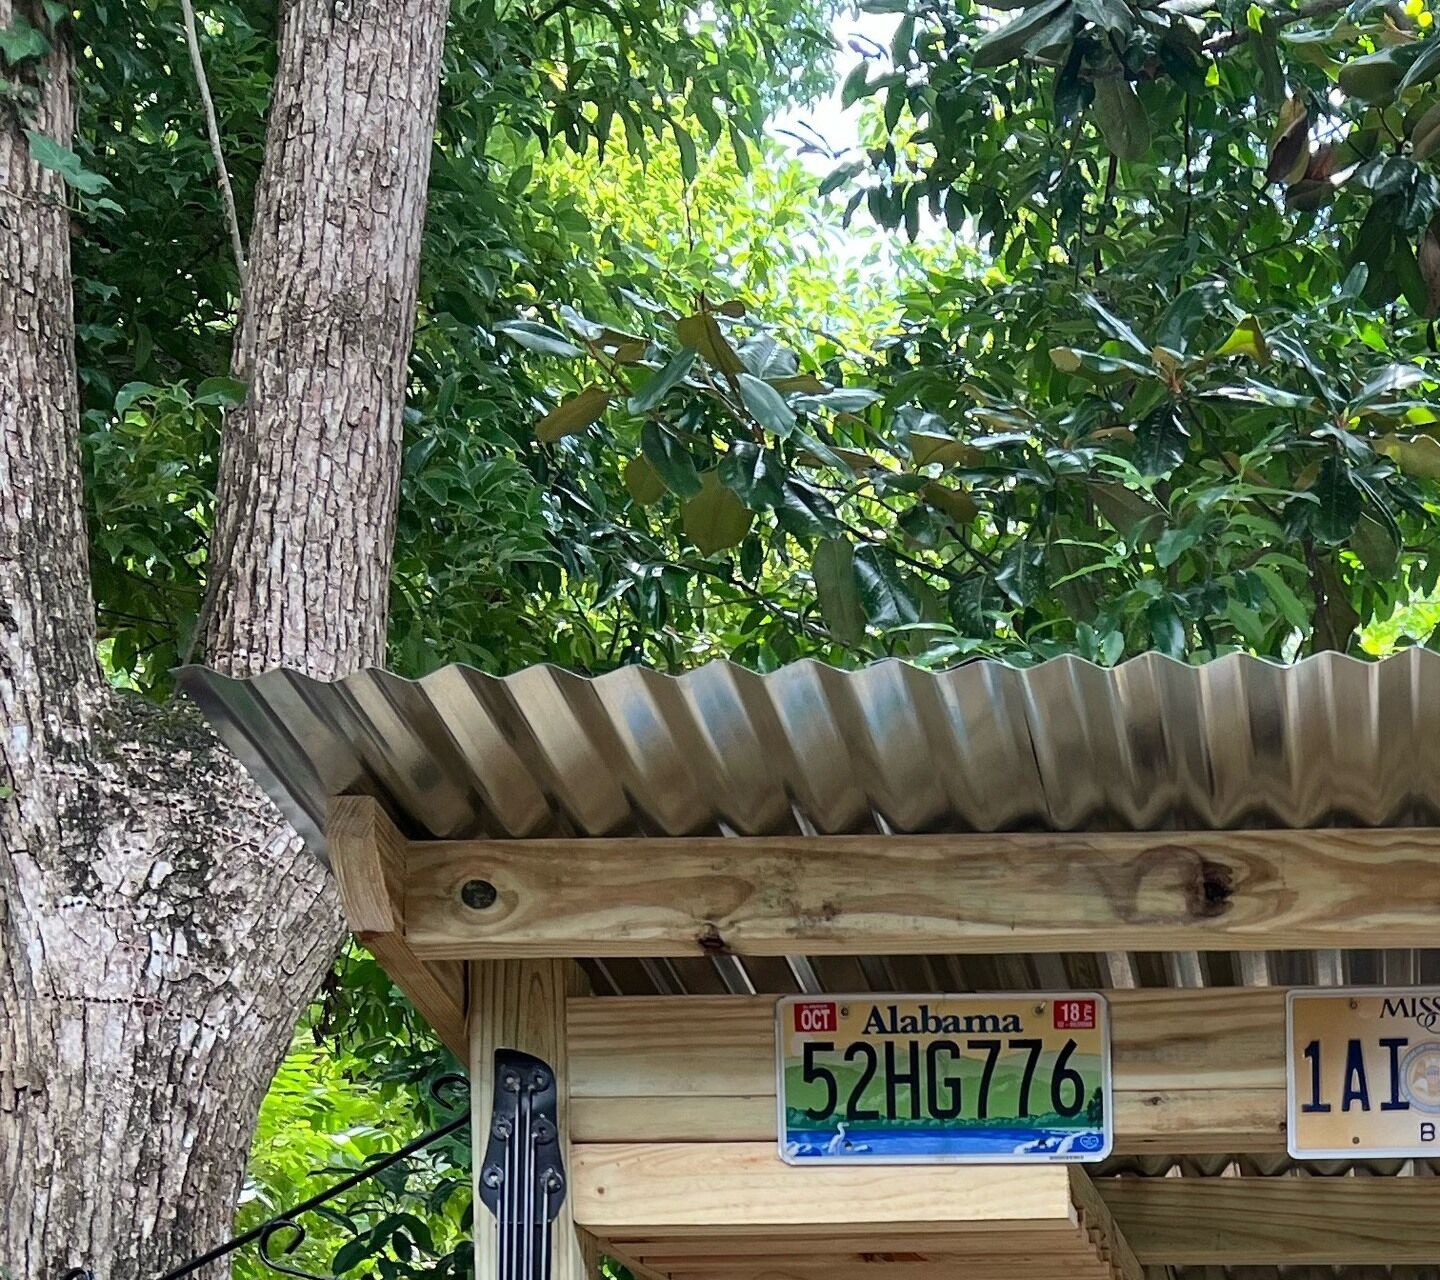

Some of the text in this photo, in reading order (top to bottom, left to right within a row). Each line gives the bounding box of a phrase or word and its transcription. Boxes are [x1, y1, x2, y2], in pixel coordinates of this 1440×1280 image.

[801, 1009, 831, 1031] OCT
[862, 1005, 1024, 1034] Alabama
[1060, 1003, 1080, 1021] 18
[802, 1038, 1085, 1121] 52HG776
[1302, 1038, 1411, 1113] 1AI
